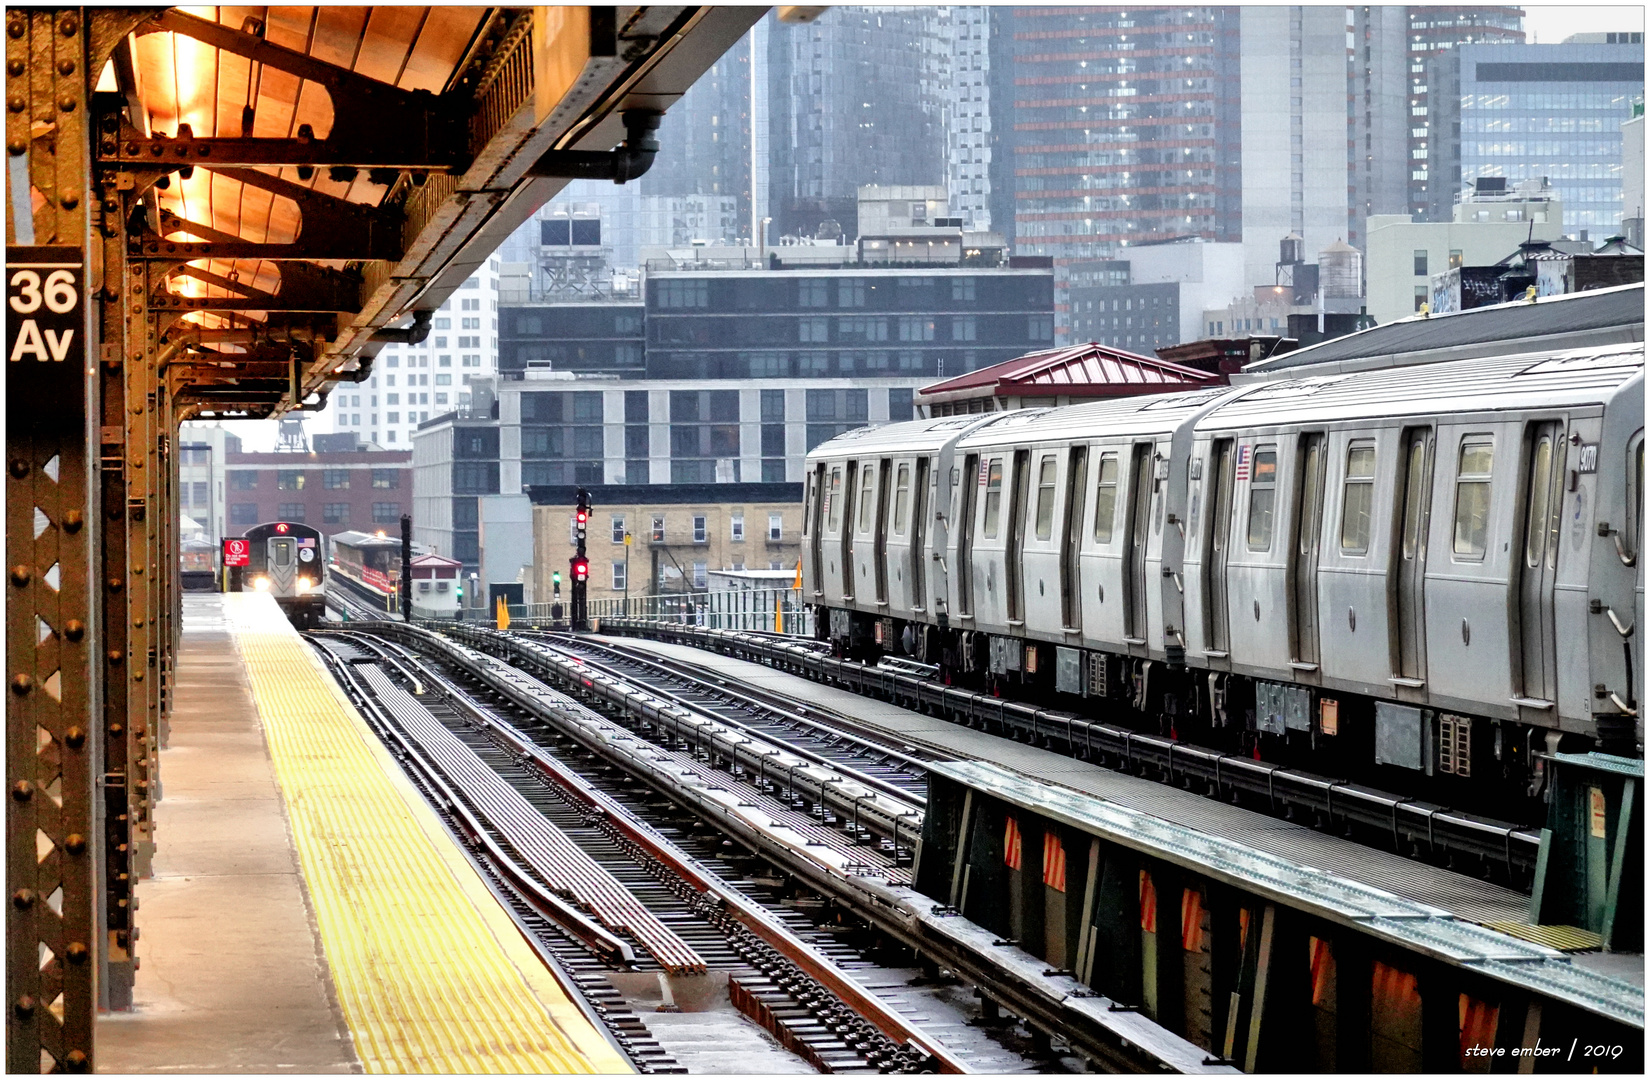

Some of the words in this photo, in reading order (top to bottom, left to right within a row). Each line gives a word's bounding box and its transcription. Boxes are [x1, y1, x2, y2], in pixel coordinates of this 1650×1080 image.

[10, 269, 78, 314] 36
[10, 319, 75, 362] Av
[1580, 445, 1597, 471] 9070
